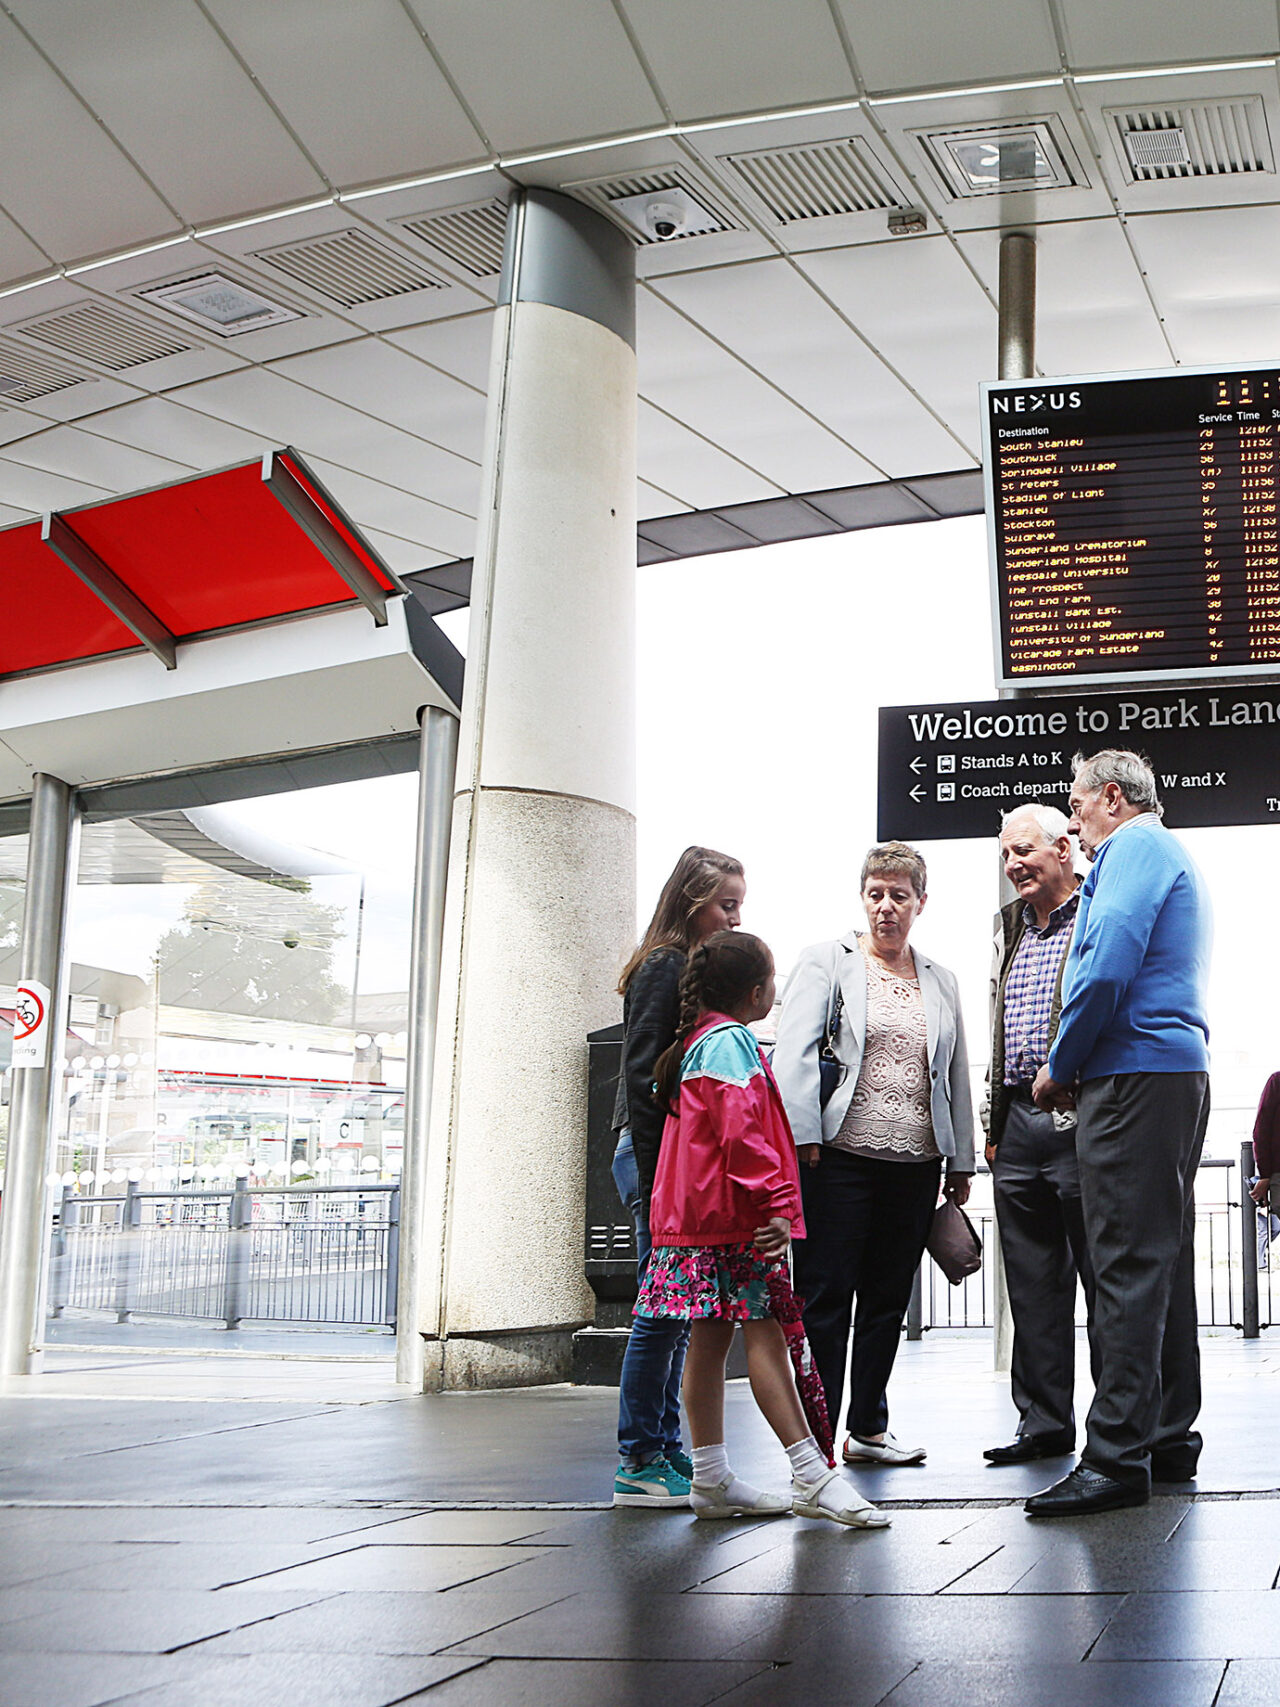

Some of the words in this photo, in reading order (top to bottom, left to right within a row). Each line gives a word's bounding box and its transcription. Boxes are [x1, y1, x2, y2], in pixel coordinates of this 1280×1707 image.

[993, 391, 1082, 414] NEXUS
[998, 426, 1049, 438] Destination
[1198, 413, 1233, 423] Service
[1236, 411, 1260, 421] Time
[908, 710, 1067, 741] Welcome
[1076, 706, 1108, 732] to
[1119, 699, 1199, 730] Park
[962, 754, 1014, 769] Stands
[1018, 754, 1029, 766] A
[1033, 753, 1047, 765] to
[1051, 752, 1062, 764] K
[961, 783, 1010, 797] Coach
[1013, 781, 1072, 797] departu
[1161, 775, 1177, 787] W
[1182, 773, 1211, 787] and
[1215, 773, 1226, 785] X
[339, 1122, 350, 1139] C
